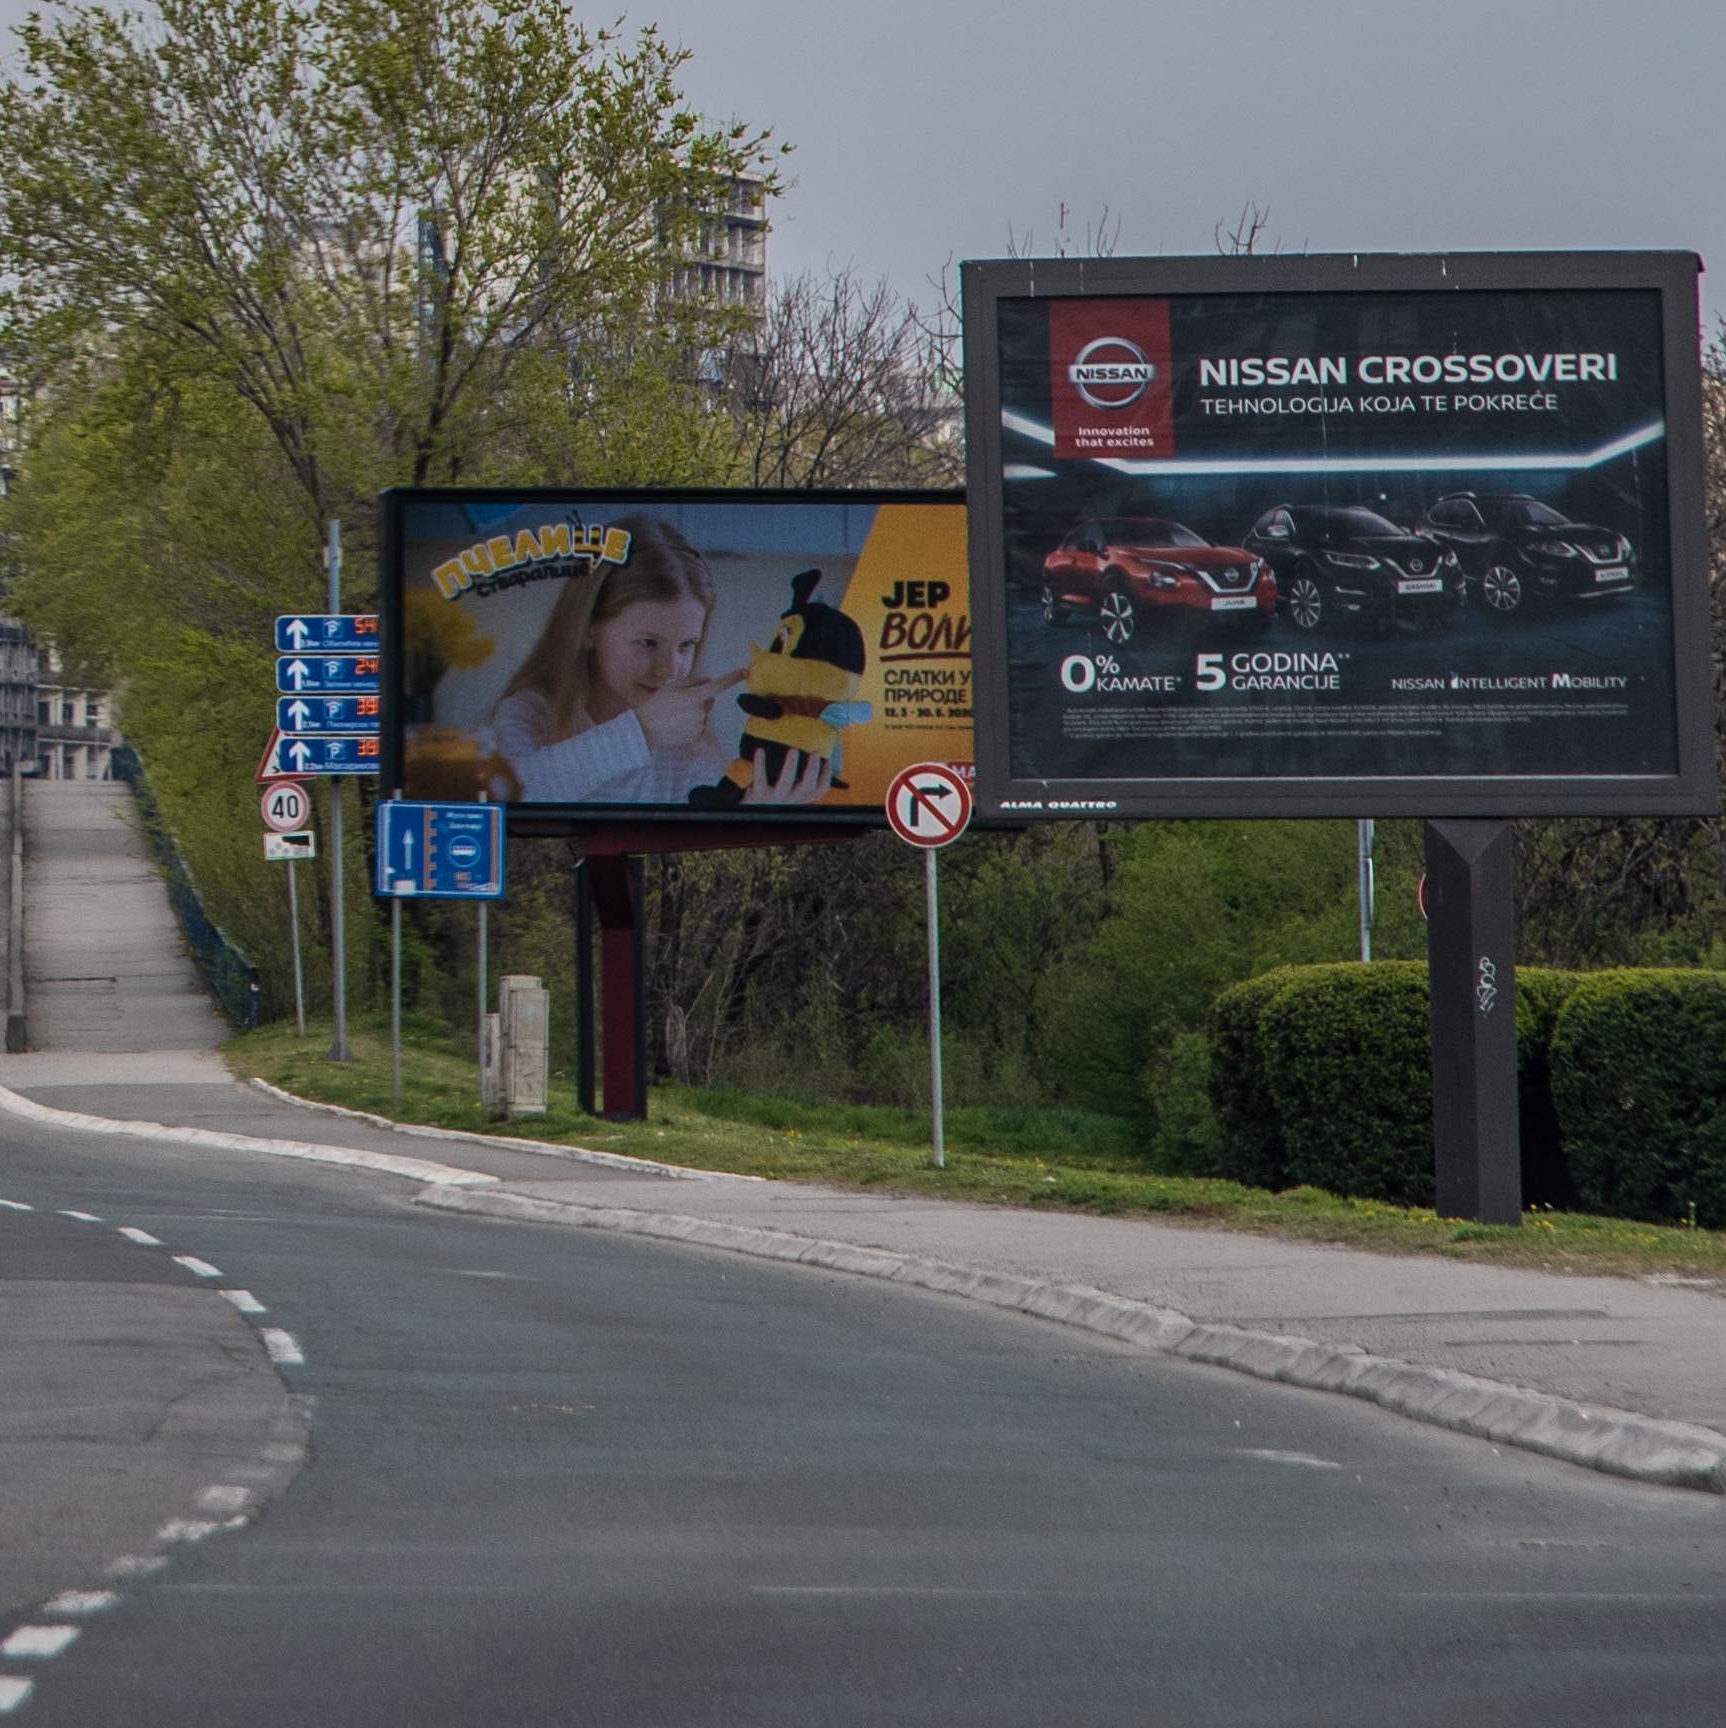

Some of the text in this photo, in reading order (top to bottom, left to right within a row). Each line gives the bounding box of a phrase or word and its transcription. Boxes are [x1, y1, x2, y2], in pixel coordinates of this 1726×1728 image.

[1076, 367, 1148, 380] NISSAN
[1199, 352, 1618, 386] NISSAN CROSSOVERI
[1200, 389, 1559, 414] TEHNOLOGIJA KOJA TE POKREĆE
[1078, 425, 1150, 437] Innovation
[1075, 437, 1154, 447] that excites
[432, 524, 631, 600] ПЧЕЛИЦЕ
[884, 669, 955, 686] СЛАТКИ
[1196, 653, 1227, 691] 5
[1232, 675, 1340, 690] GARANCIJE
[1391, 677, 1445, 690] NISSAN
[884, 688, 968, 704] ПРИРОДЕ
[272, 795, 299, 819] 40
[999, 800, 1117, 809] ALMA QUATTRO
